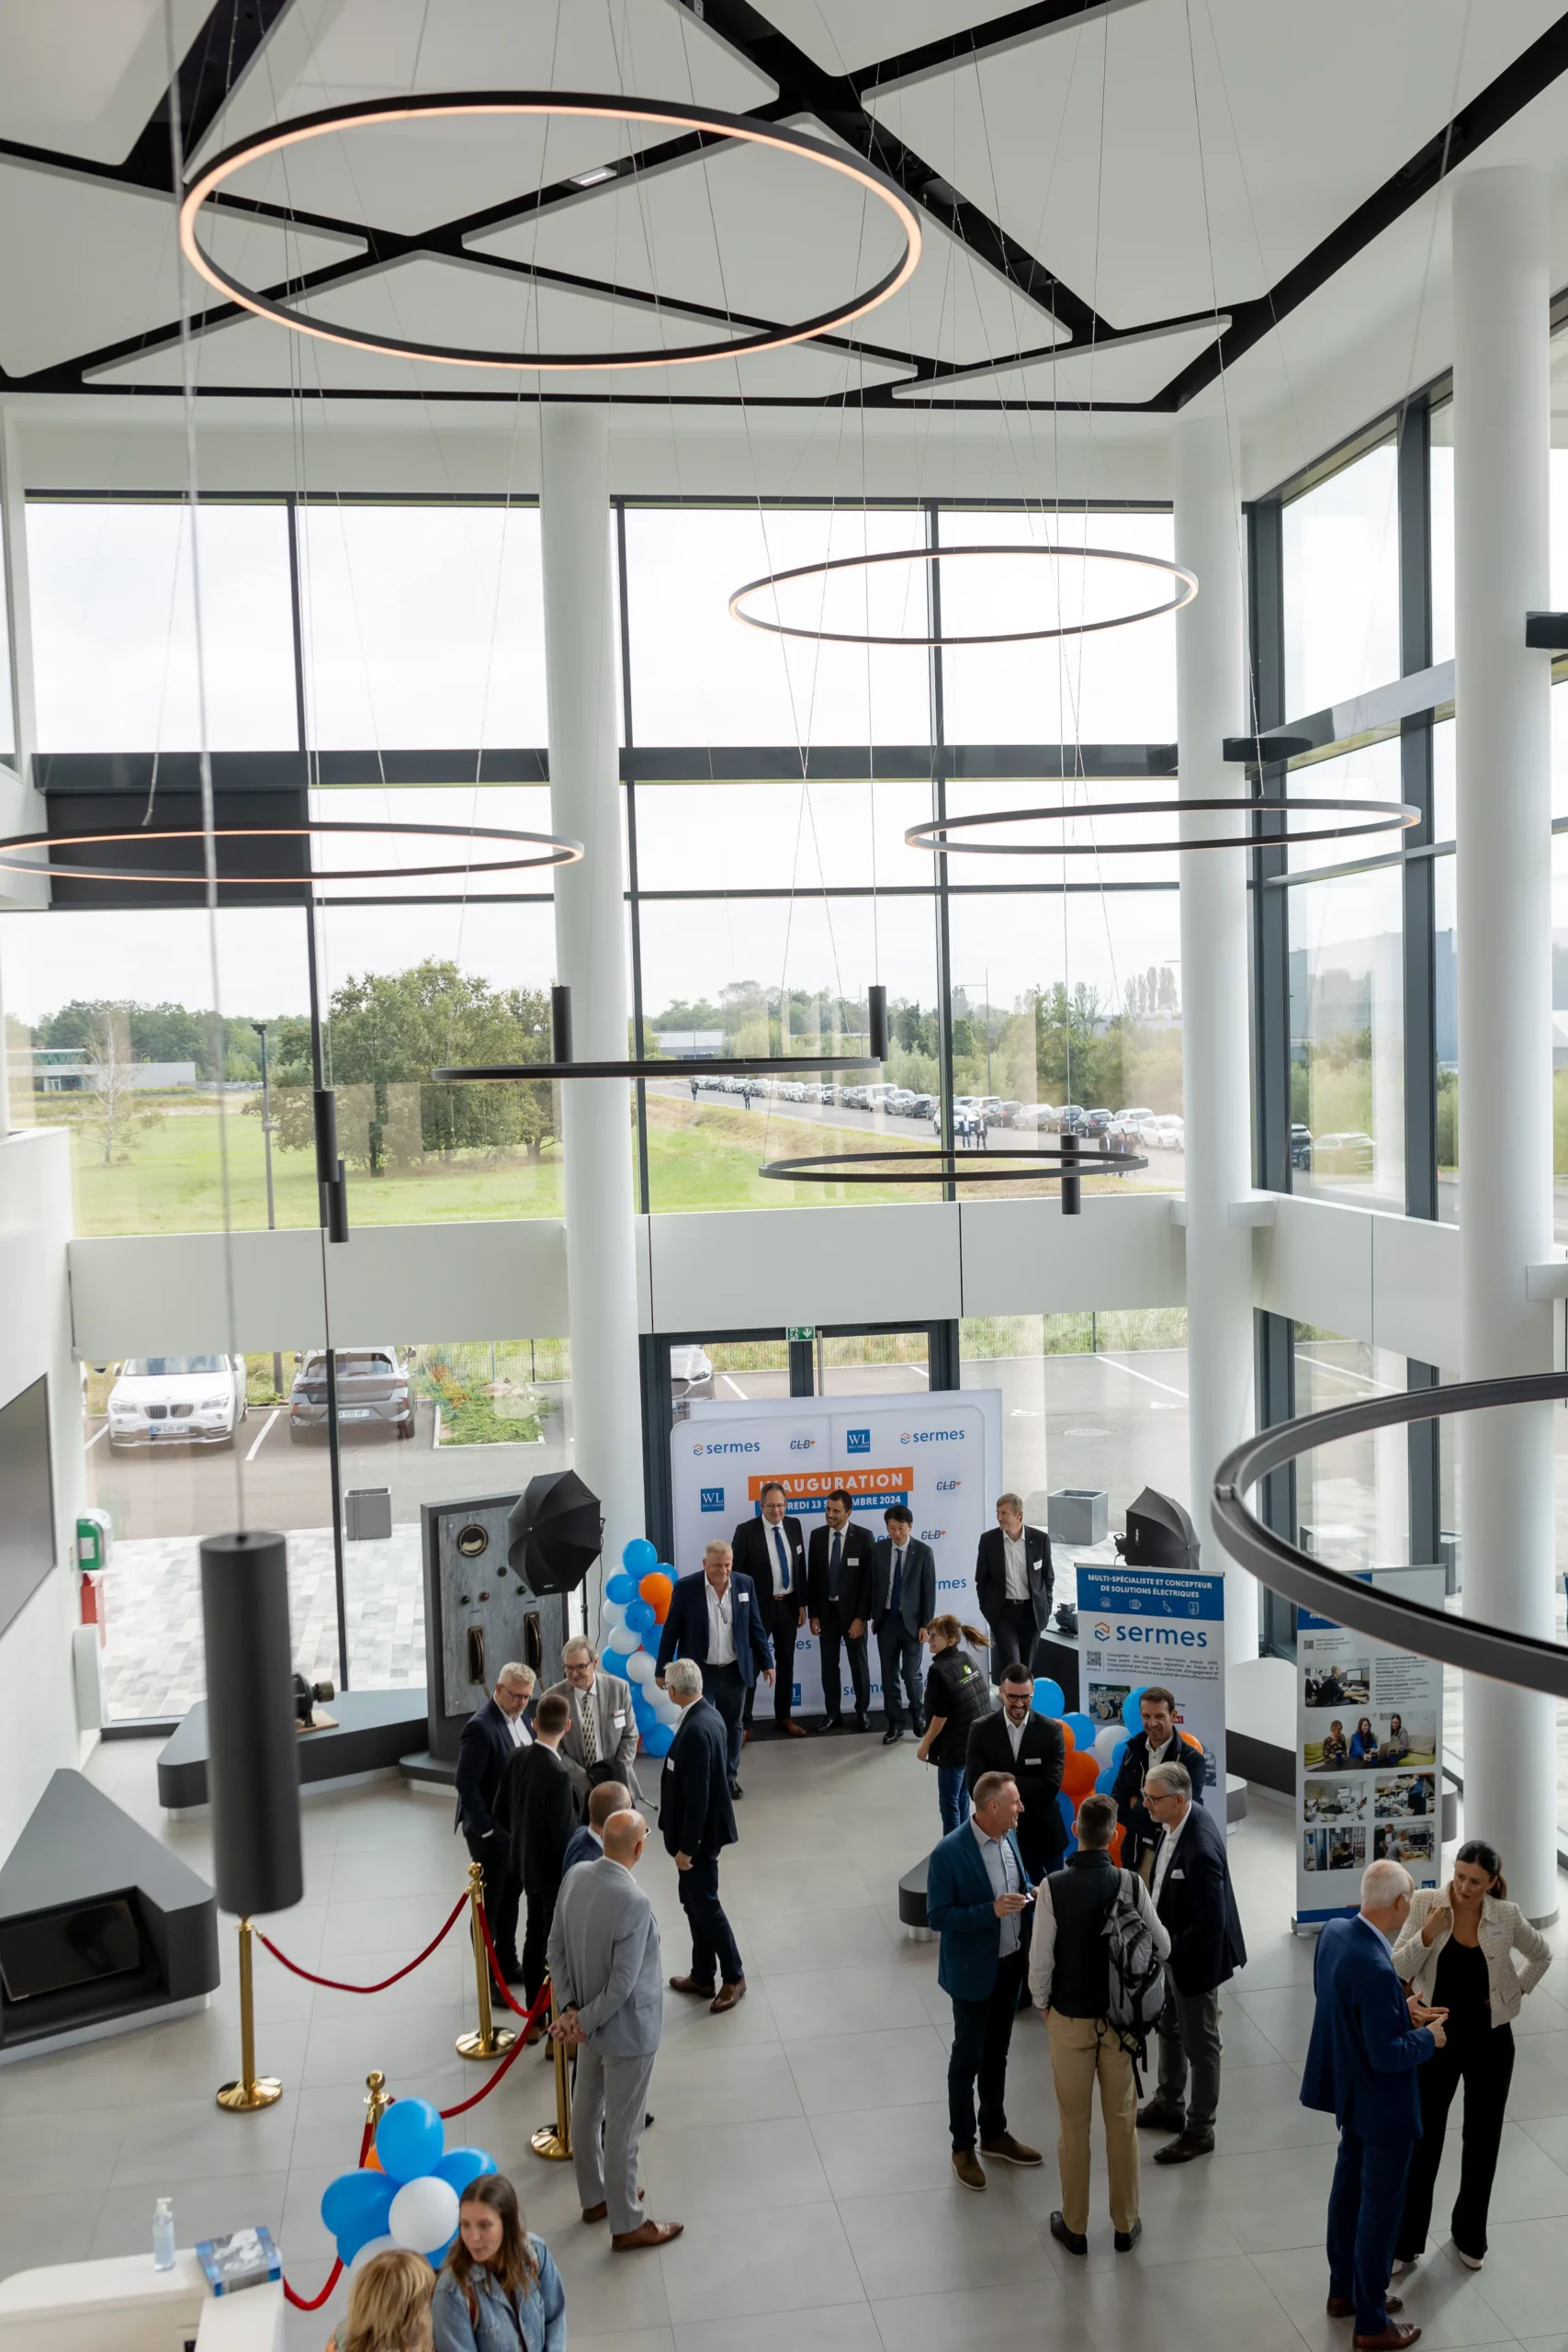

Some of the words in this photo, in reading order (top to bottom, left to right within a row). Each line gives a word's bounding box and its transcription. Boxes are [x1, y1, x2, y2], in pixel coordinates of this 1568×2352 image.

[849, 1433, 870, 1445] WL
[913, 1430, 965, 1443] sermes
[706, 1442, 761, 1454] sermes
[790, 1440, 811, 1450] CLD
[760, 1473, 903, 1496] IAUGURATION
[936, 1480, 956, 1491] CLD
[702, 1492, 724, 1504] WL
[811, 1500, 822, 1509] 13
[879, 1495, 901, 1505] 2024
[920, 1530, 942, 1540] CLD
[935, 1578, 967, 1590] mes
[1088, 1574, 1155, 1586] MULTI-SPÉCIALISTE
[1165, 1579, 1213, 1589] CONCEPTEUR
[1111, 1586, 1152, 1595] SOLUTIONS
[1152, 1587, 1200, 1599] ÉLECTRIQUES
[1116, 1625, 1208, 1647] sermes
